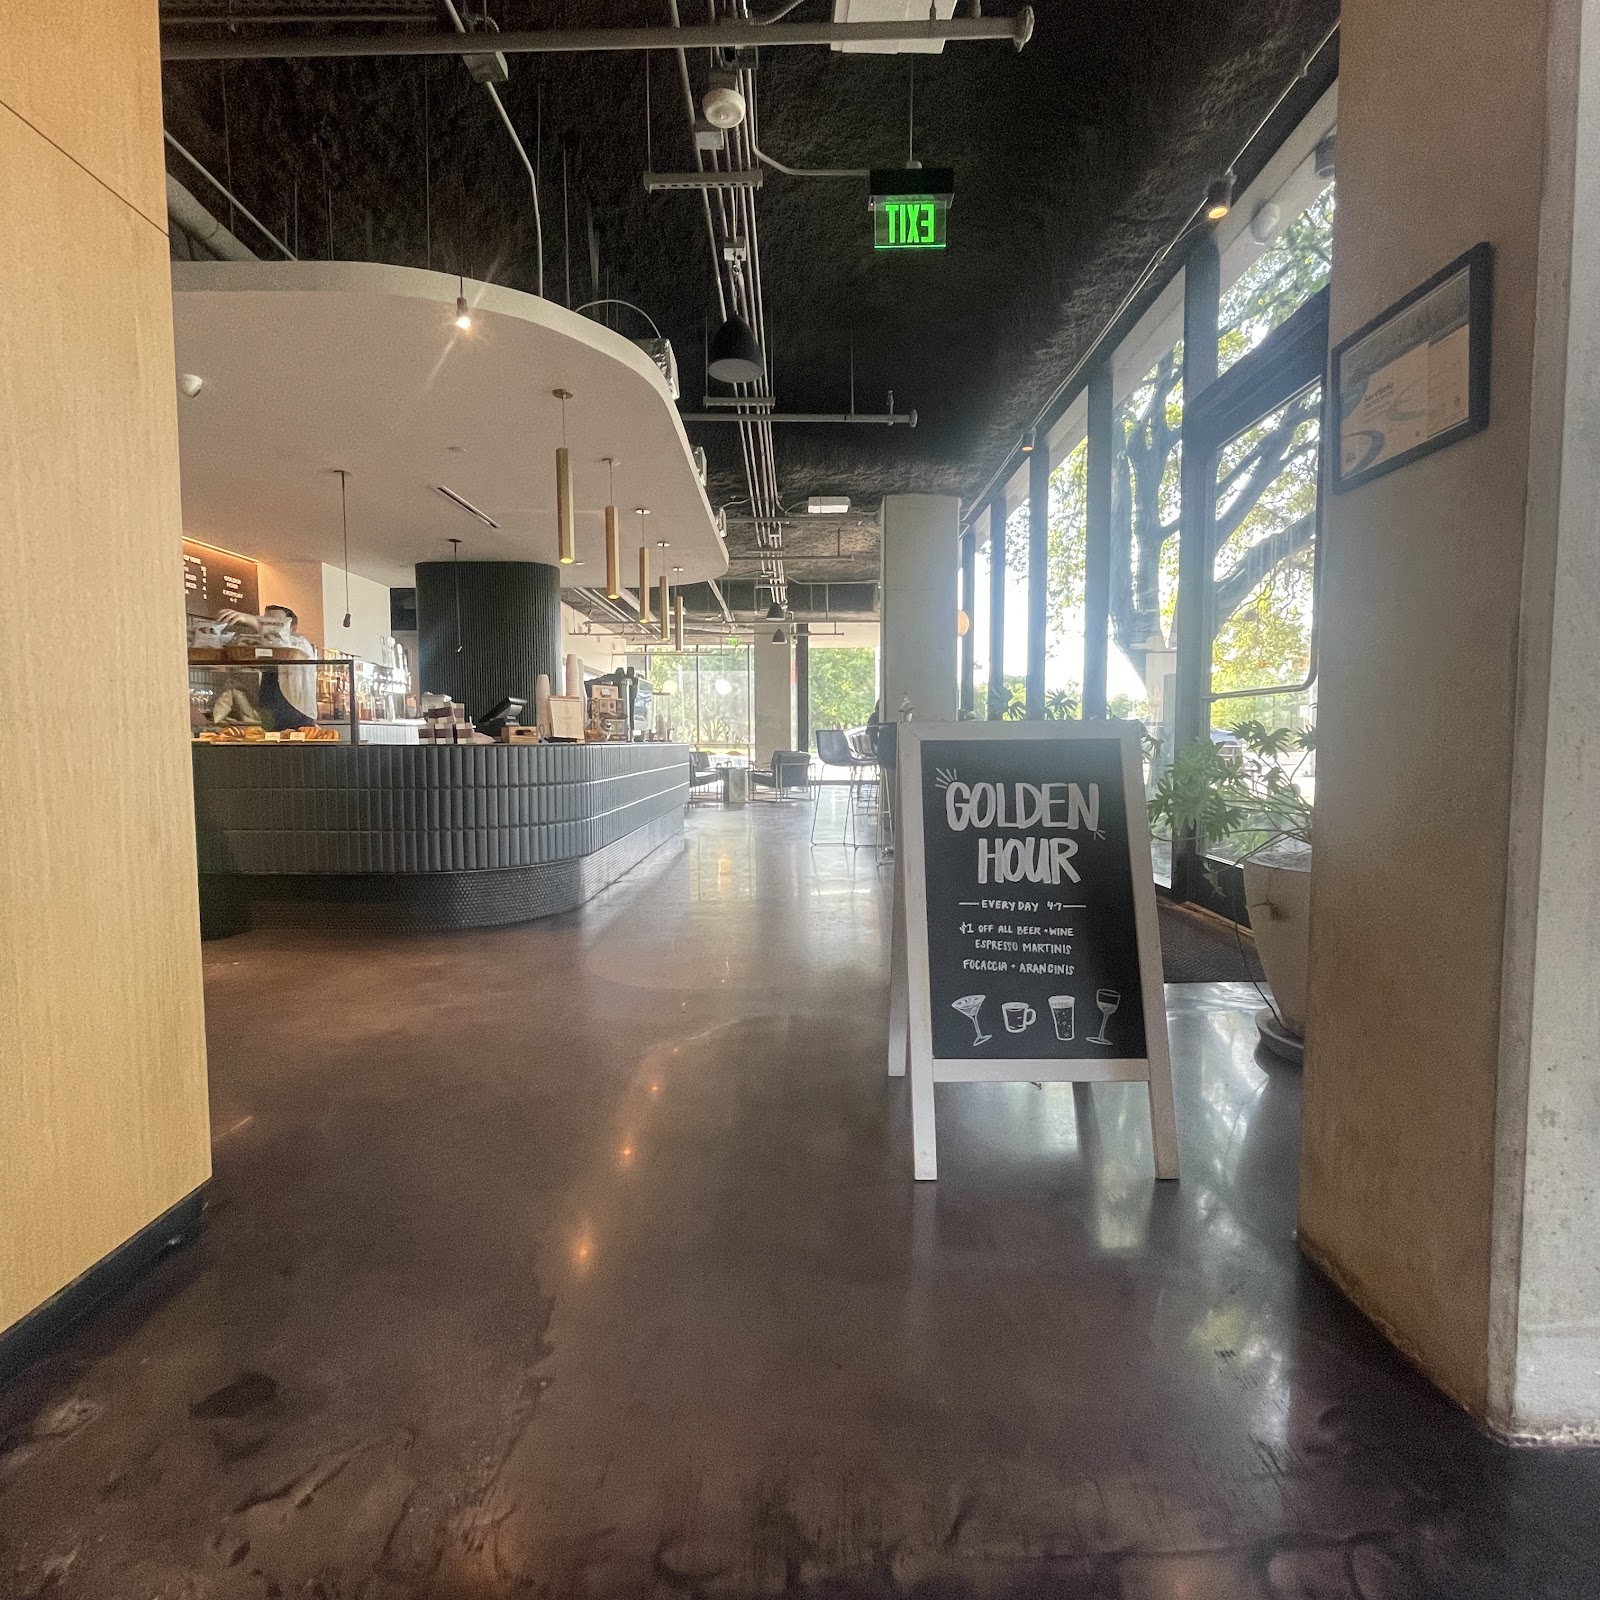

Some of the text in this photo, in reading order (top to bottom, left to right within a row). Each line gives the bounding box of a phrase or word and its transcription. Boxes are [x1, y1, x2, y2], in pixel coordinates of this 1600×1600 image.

[945, 781, 1099, 831] GOLDEN
[977, 837, 1082, 884] HOUR
[959, 921, 974, 934] $1
[978, 924, 994, 933] OFF
[998, 925, 1013, 934] ALL
[1017, 926, 1041, 935] BEER
[1049, 927, 1074, 936] WINE
[975, 939, 1072, 954] ESPRESSO MARTINIS
[963, 959, 1007, 971] FOCACCIA
[1019, 963, 1075, 975] ARANCINIS
